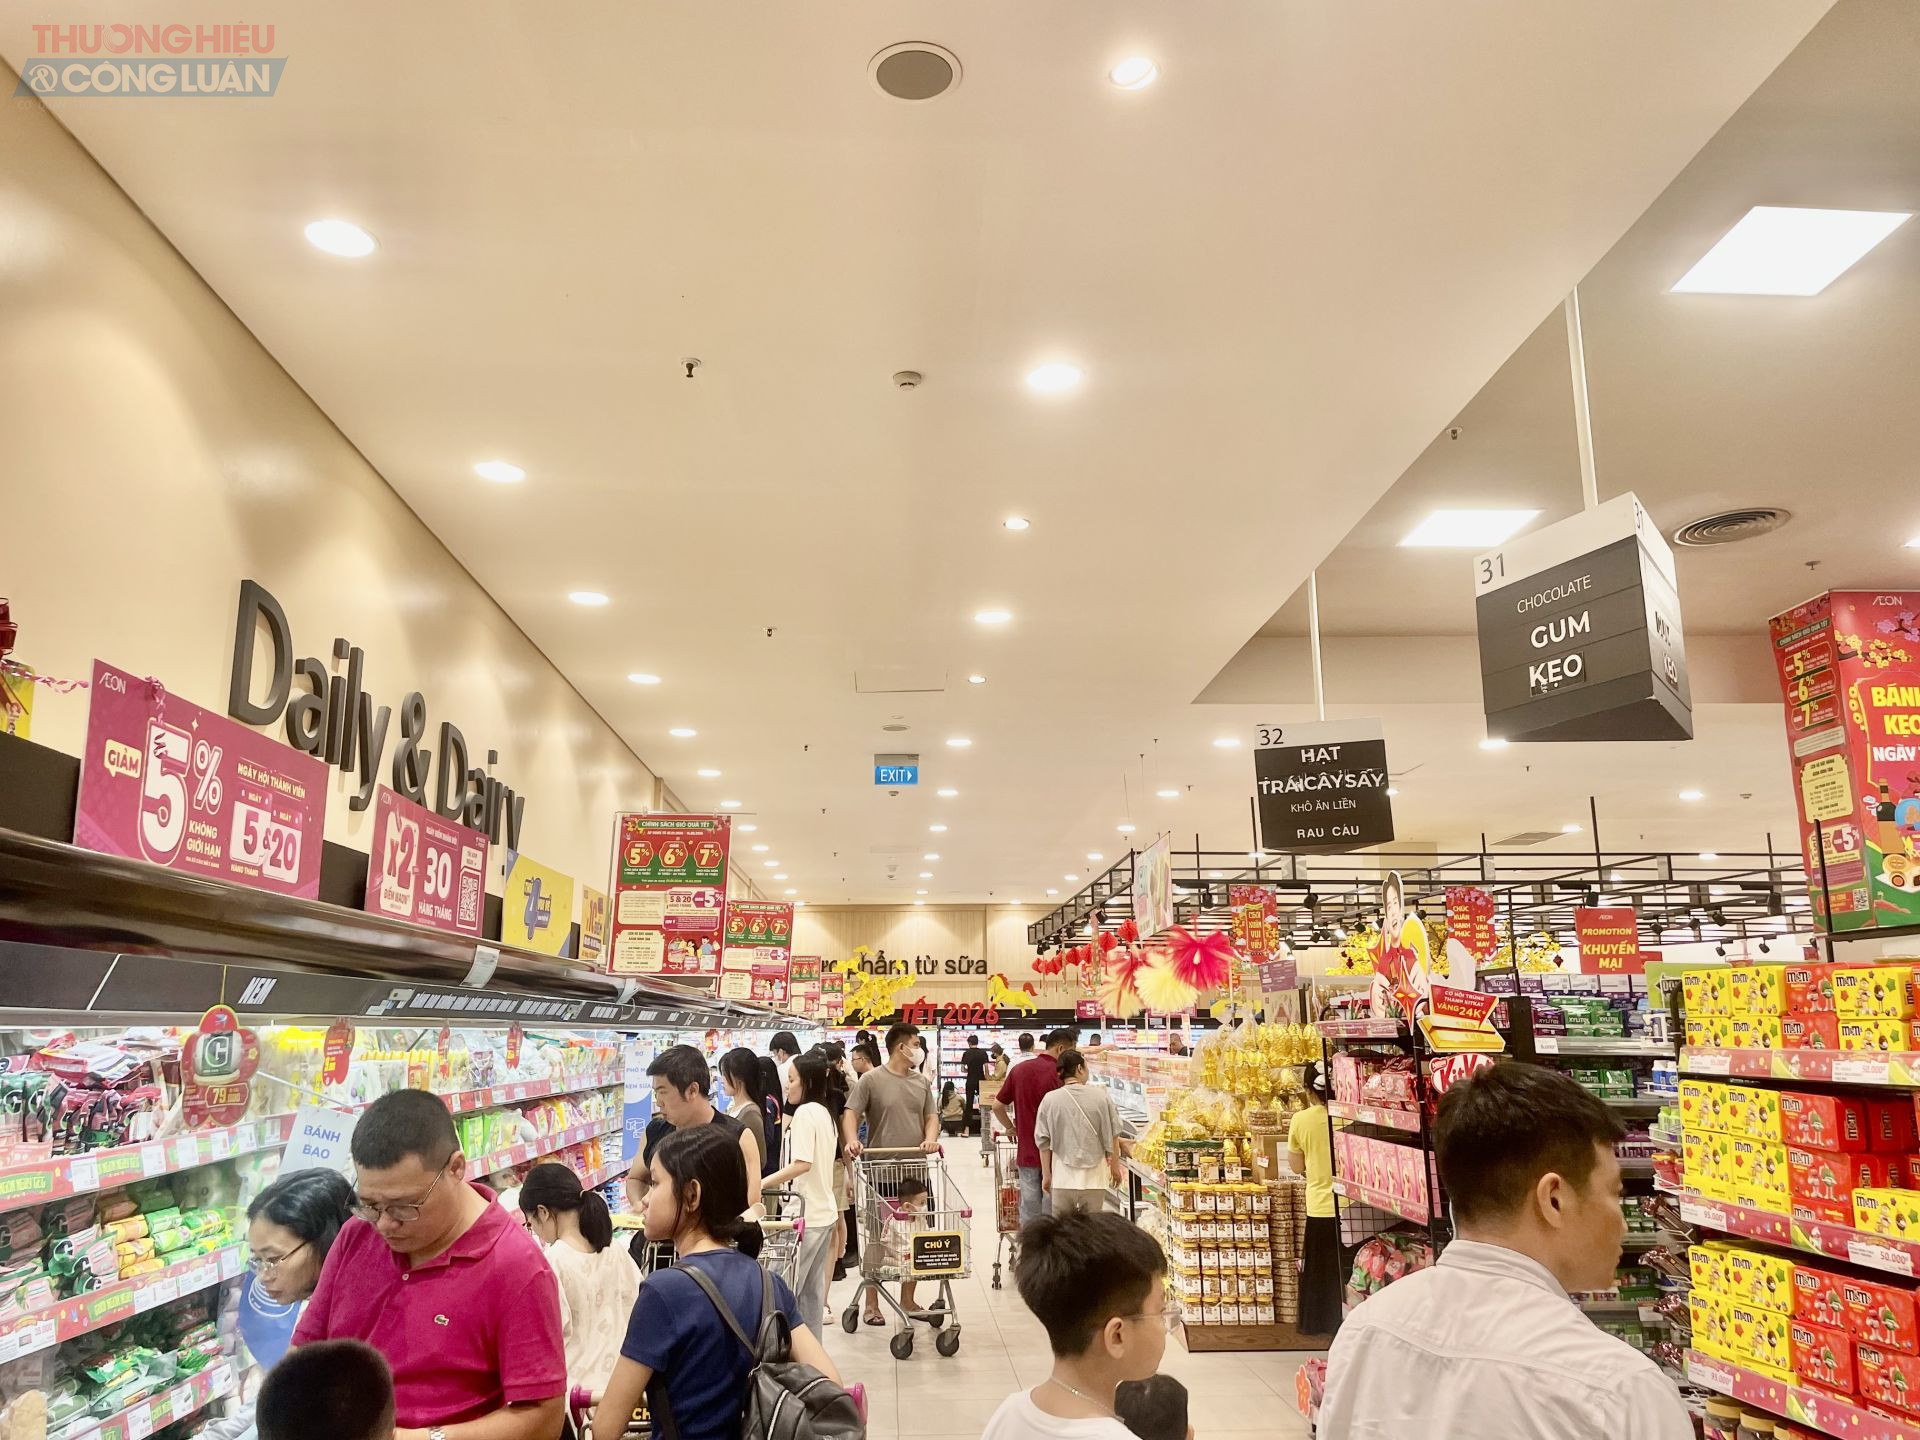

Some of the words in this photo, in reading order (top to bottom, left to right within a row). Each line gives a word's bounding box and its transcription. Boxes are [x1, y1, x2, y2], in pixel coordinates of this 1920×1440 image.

[1480, 553, 1504, 584] 31
[1517, 574, 1591, 613] CHOCOLATE
[1531, 611, 1590, 648] GUM
[1529, 654, 1583, 687] KẸO
[228, 579, 391, 811] Daily
[392, 692, 431, 809] &
[436, 721, 525, 849] Dairy
[1260, 728, 1284, 746] 32
[108, 747, 139, 773] GIẢM
[1301, 746, 1340, 765] HẠT
[237, 762, 257, 780] NGÀY
[258, 770, 269, 785] HỘI
[270, 776, 291, 793] THÀNH
[292, 784, 305, 799] VIÊN
[880, 769, 905, 782] EXIT
[1291, 800, 1312, 813] KHÔ
[1315, 799, 1330, 811] ĂN
[189, 820, 218, 839] KHÔNG
[1297, 828, 1324, 839] RAU
[186, 837, 203, 853] GIỚI
[204, 843, 221, 860] HẠN
[243, 809, 259, 855] 5
[270, 828, 297, 871] 20
[629, 848, 649, 865] 5%
[663, 848, 684, 865] 6%
[699, 849, 719, 866] 7%
[424, 847, 452, 899] 30
[1582, 927, 1632, 936] PROMOTION
[1582, 940, 1636, 955] KHUYẾN
[915, 955, 938, 975] từ
[944, 955, 987, 975] sữa
[1598, 957, 1623, 971] MẠI
[902, 996, 937, 1025] TẾT
[943, 1002, 1000, 1025] 2026
[1437, 1002, 1460, 1012] VÀNG
[304, 1124, 341, 1143] BÁNH
[302, 1144, 330, 1159] BAO
[924, 1240, 942, 1249] CHÚ
[944, 1239, 950, 1248] Ý
